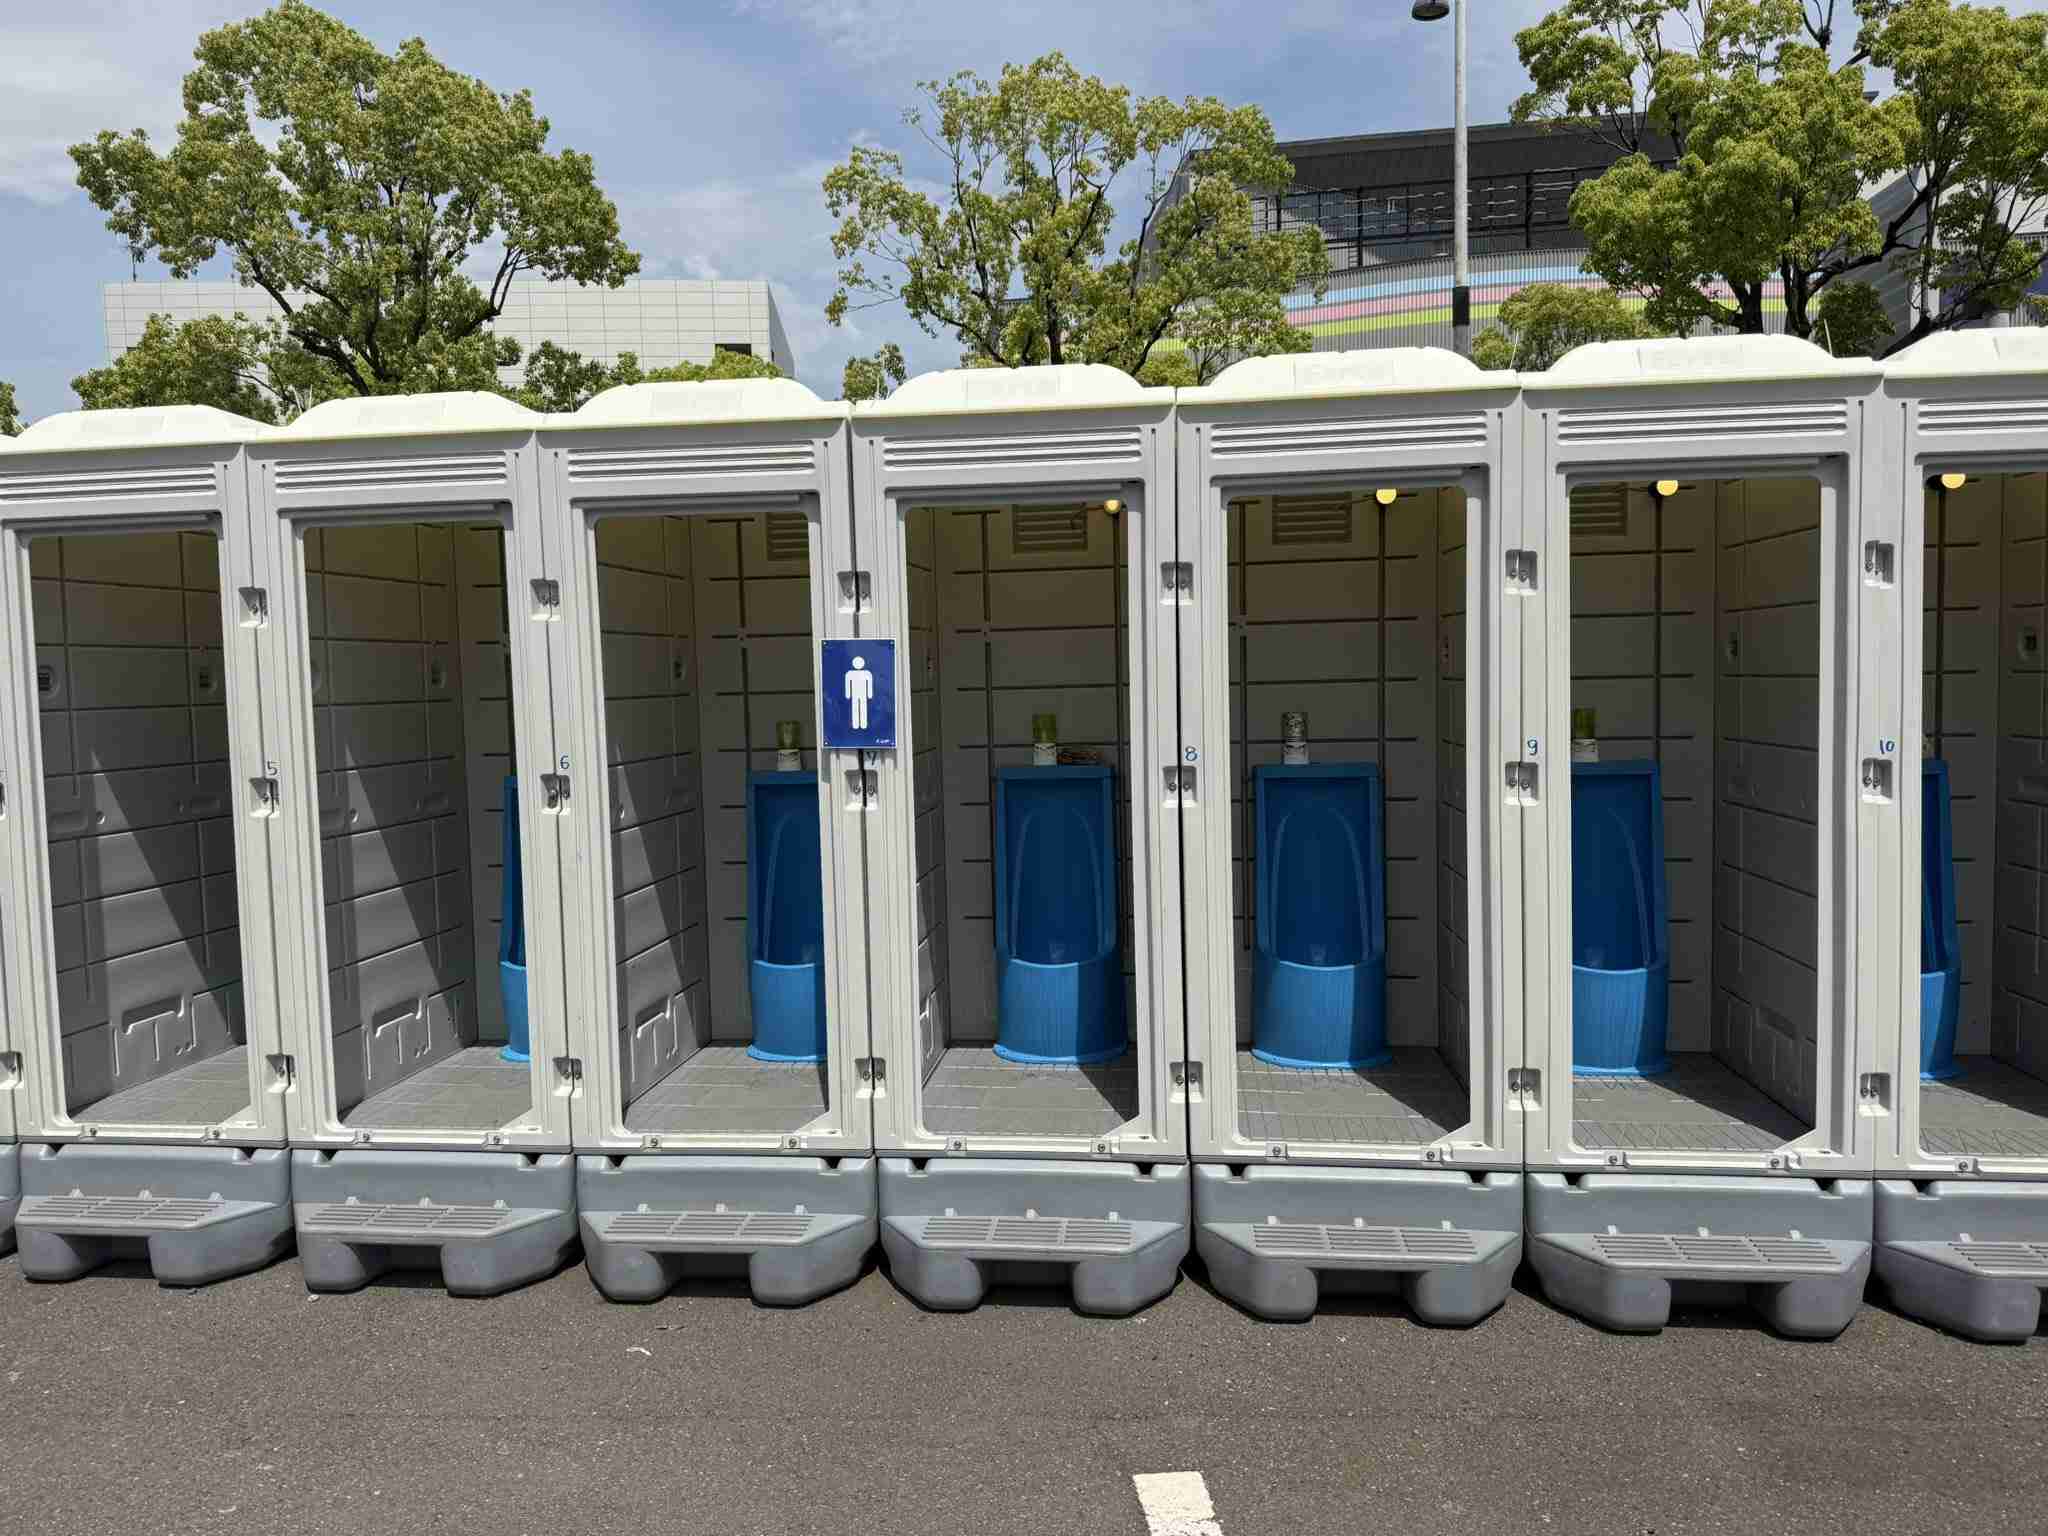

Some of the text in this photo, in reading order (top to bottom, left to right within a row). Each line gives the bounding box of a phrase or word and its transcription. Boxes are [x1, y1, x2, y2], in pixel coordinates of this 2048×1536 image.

[1185, 746, 1198, 761] 8
[1527, 739, 1538, 756] 9
[1879, 739, 1896, 755] 10
[267, 760, 278, 776] 5
[560, 755, 570, 770] 6
